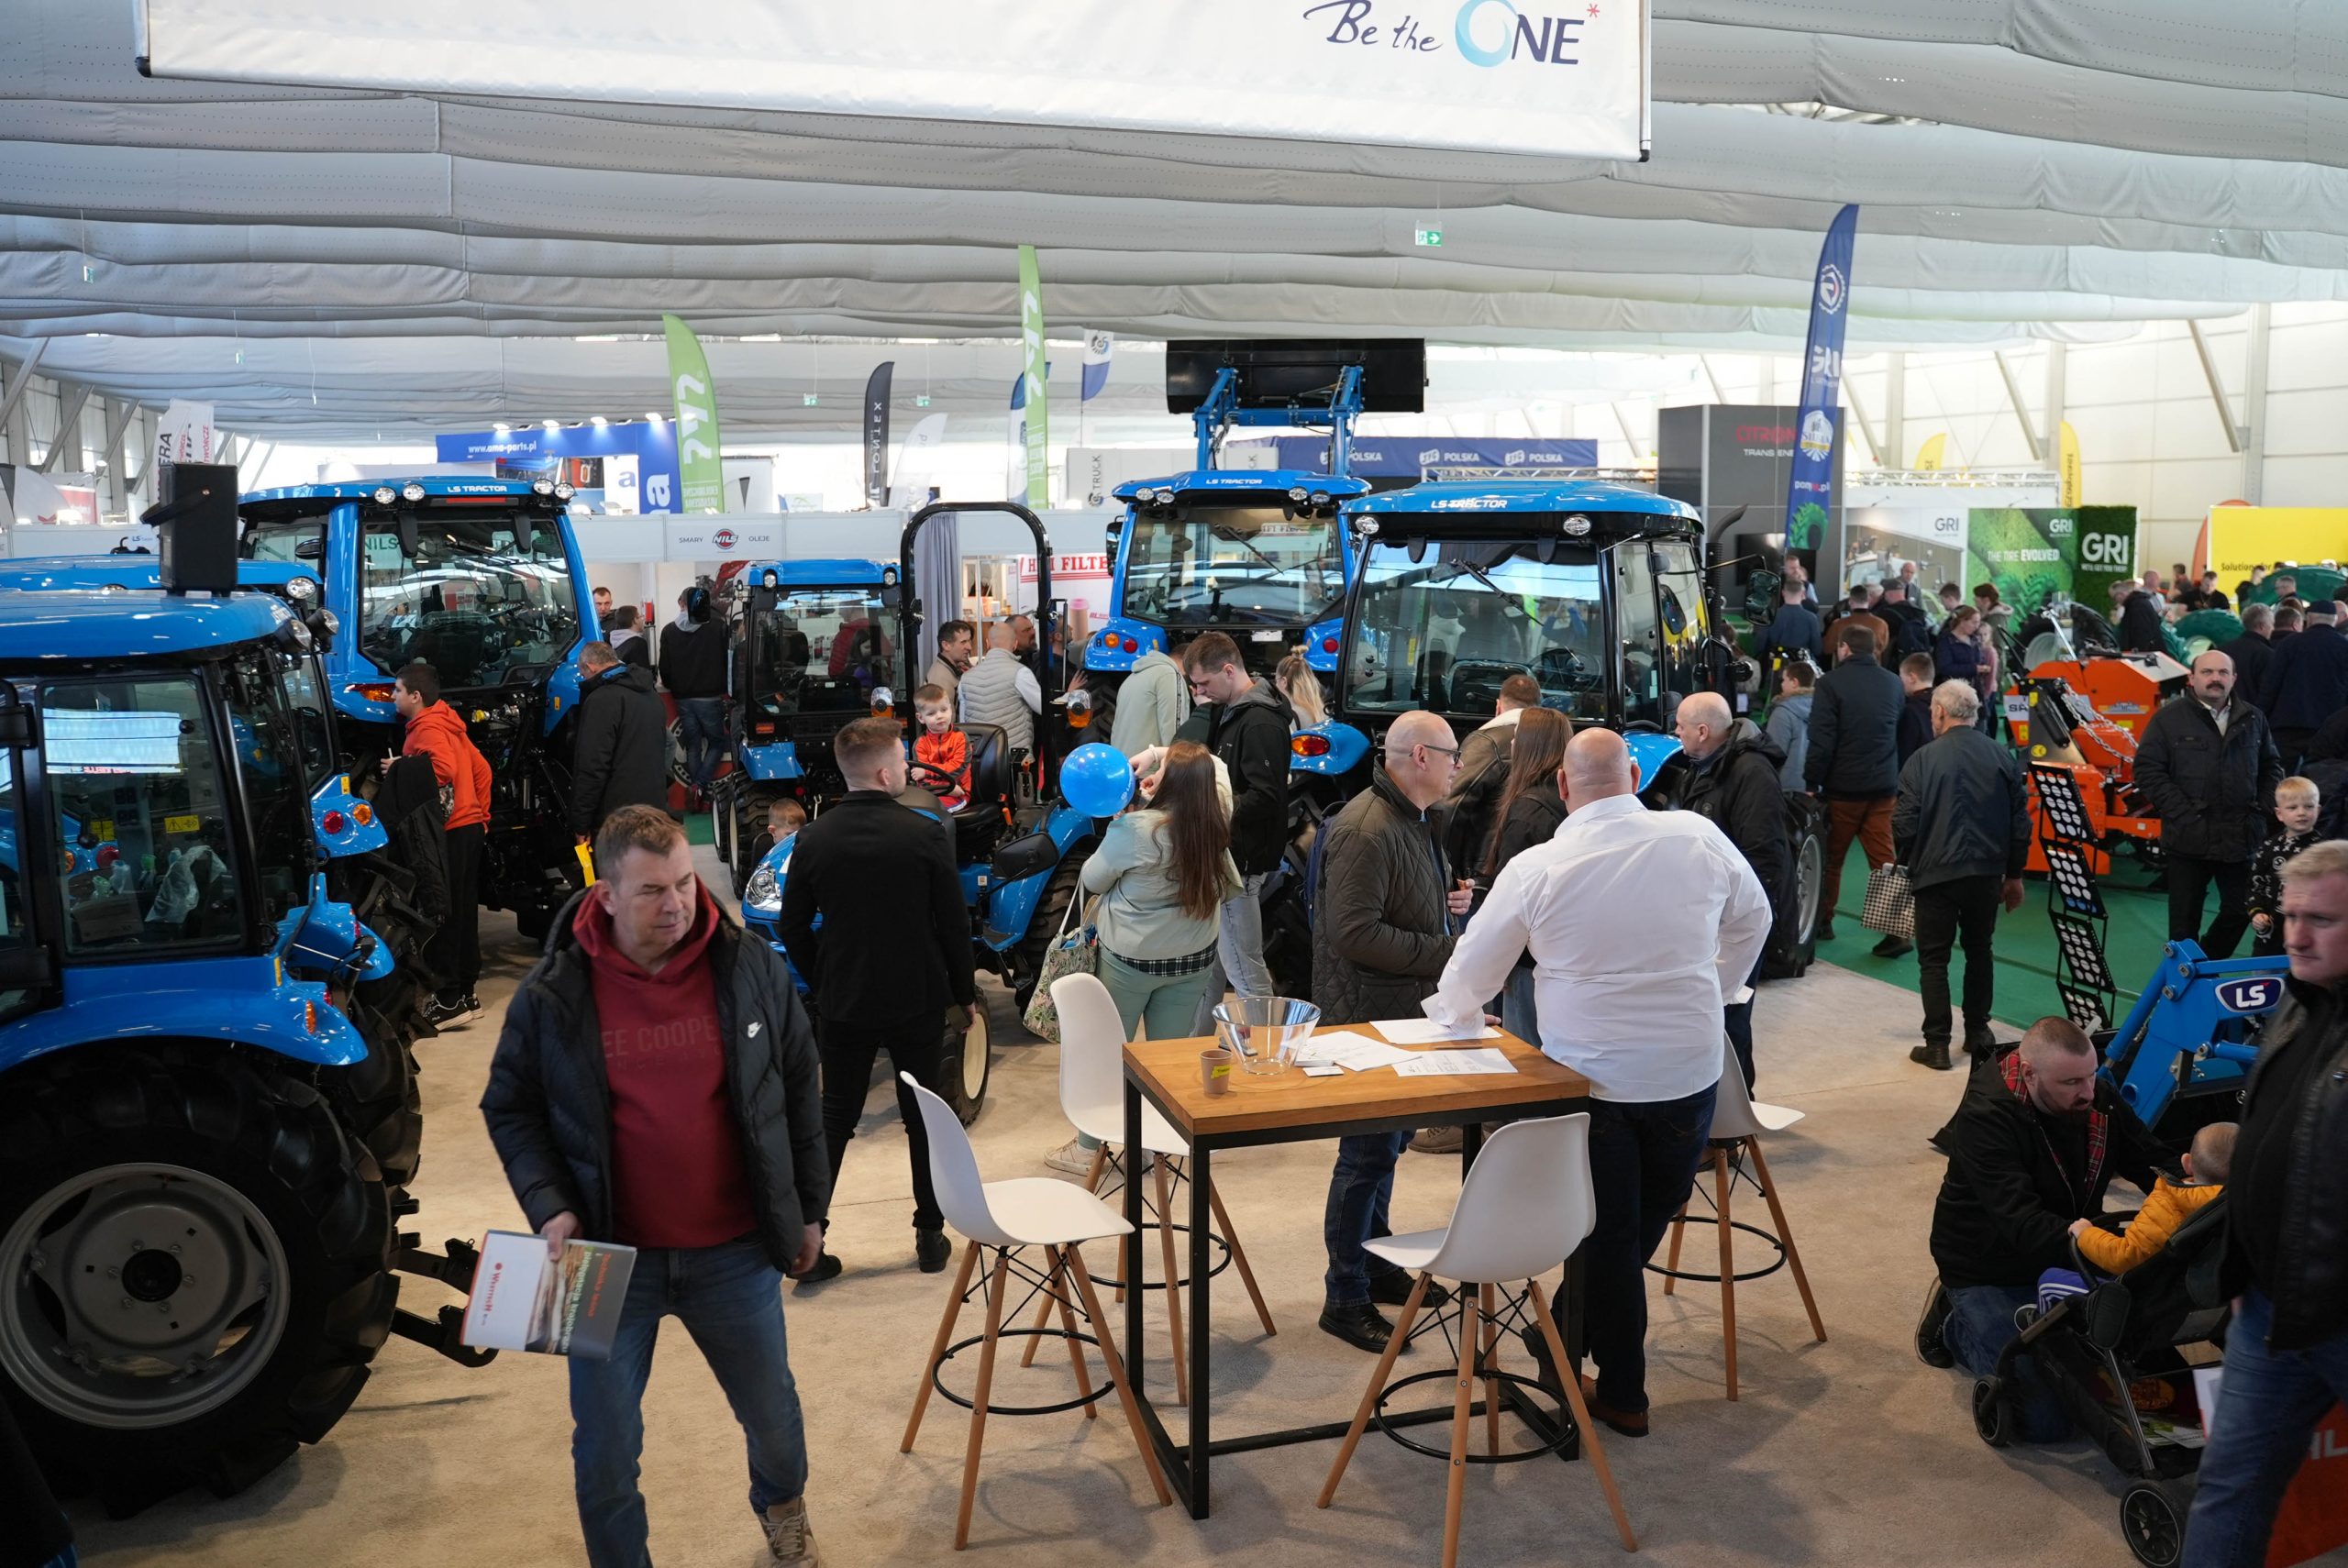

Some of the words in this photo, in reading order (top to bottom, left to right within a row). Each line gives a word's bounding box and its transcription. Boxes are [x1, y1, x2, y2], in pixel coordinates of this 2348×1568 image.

[1302, 0, 1379, 45] Be
[1391, 16, 1444, 51] the
[1735, 425, 1797, 444] CITRON
[468, 440, 537, 454] www.ama-parts.pl
[1744, 448, 1775, 457] TRANS
[1444, 453, 1479, 462] POLSKA
[1529, 453, 1564, 463] POLSKA
[1092, 454, 1102, 488] TRUCK
[1431, 501, 1447, 509] LS
[1448, 499, 1508, 509] TRACTOR
[1934, 517, 1959, 532] GRI
[2049, 519, 2073, 533] GRI
[712, 535, 738, 544] NILS
[2021, 548, 2061, 561] EVOLVED
[2081, 531, 2130, 565] GRI
[1061, 556, 1109, 571] FILTE
[2236, 984, 2266, 1008] LS
[602, 1028, 629, 1058] EE
[637, 1014, 718, 1053] COOPE
